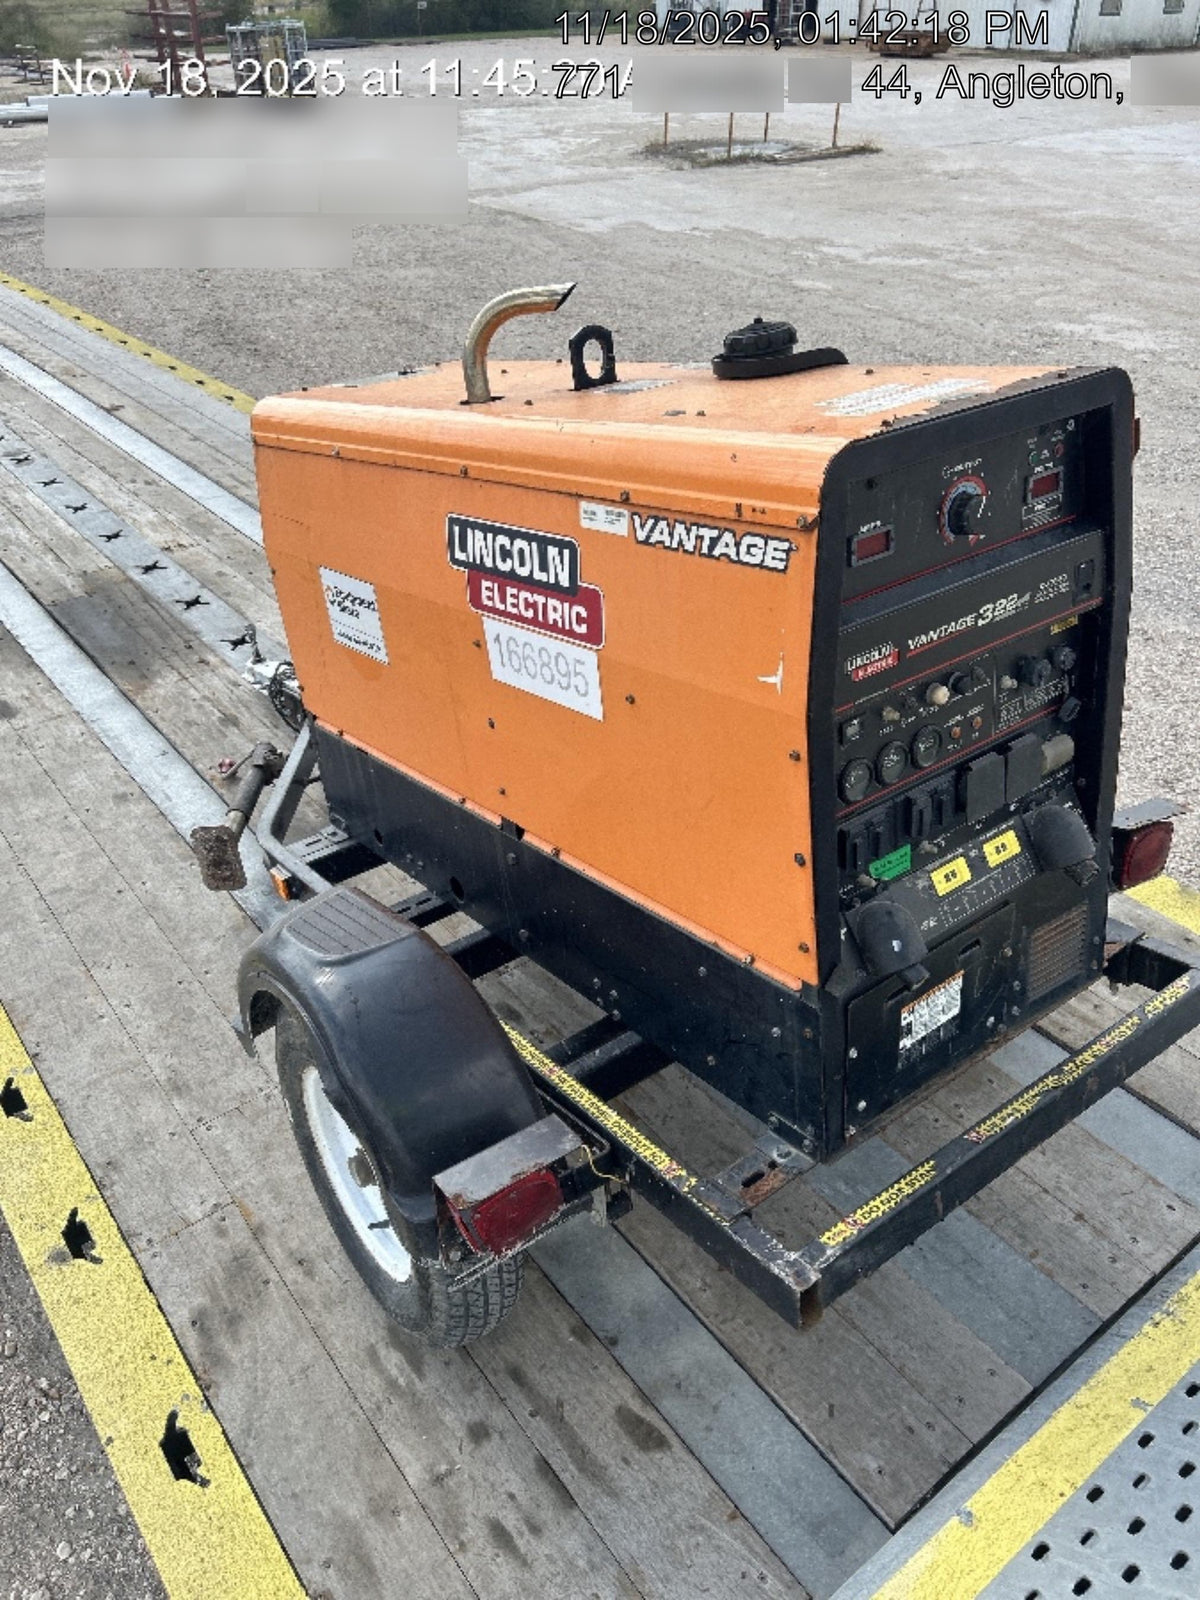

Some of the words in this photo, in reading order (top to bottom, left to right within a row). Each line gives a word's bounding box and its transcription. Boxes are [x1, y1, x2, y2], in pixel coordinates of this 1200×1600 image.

[453, 525, 570, 588] LINCOLN
[631, 513, 791, 572] VANTAGE
[481, 579, 588, 634] ELECTRIC
[907, 612, 976, 650] VANTAGE
[493, 632, 590, 698] 166895
